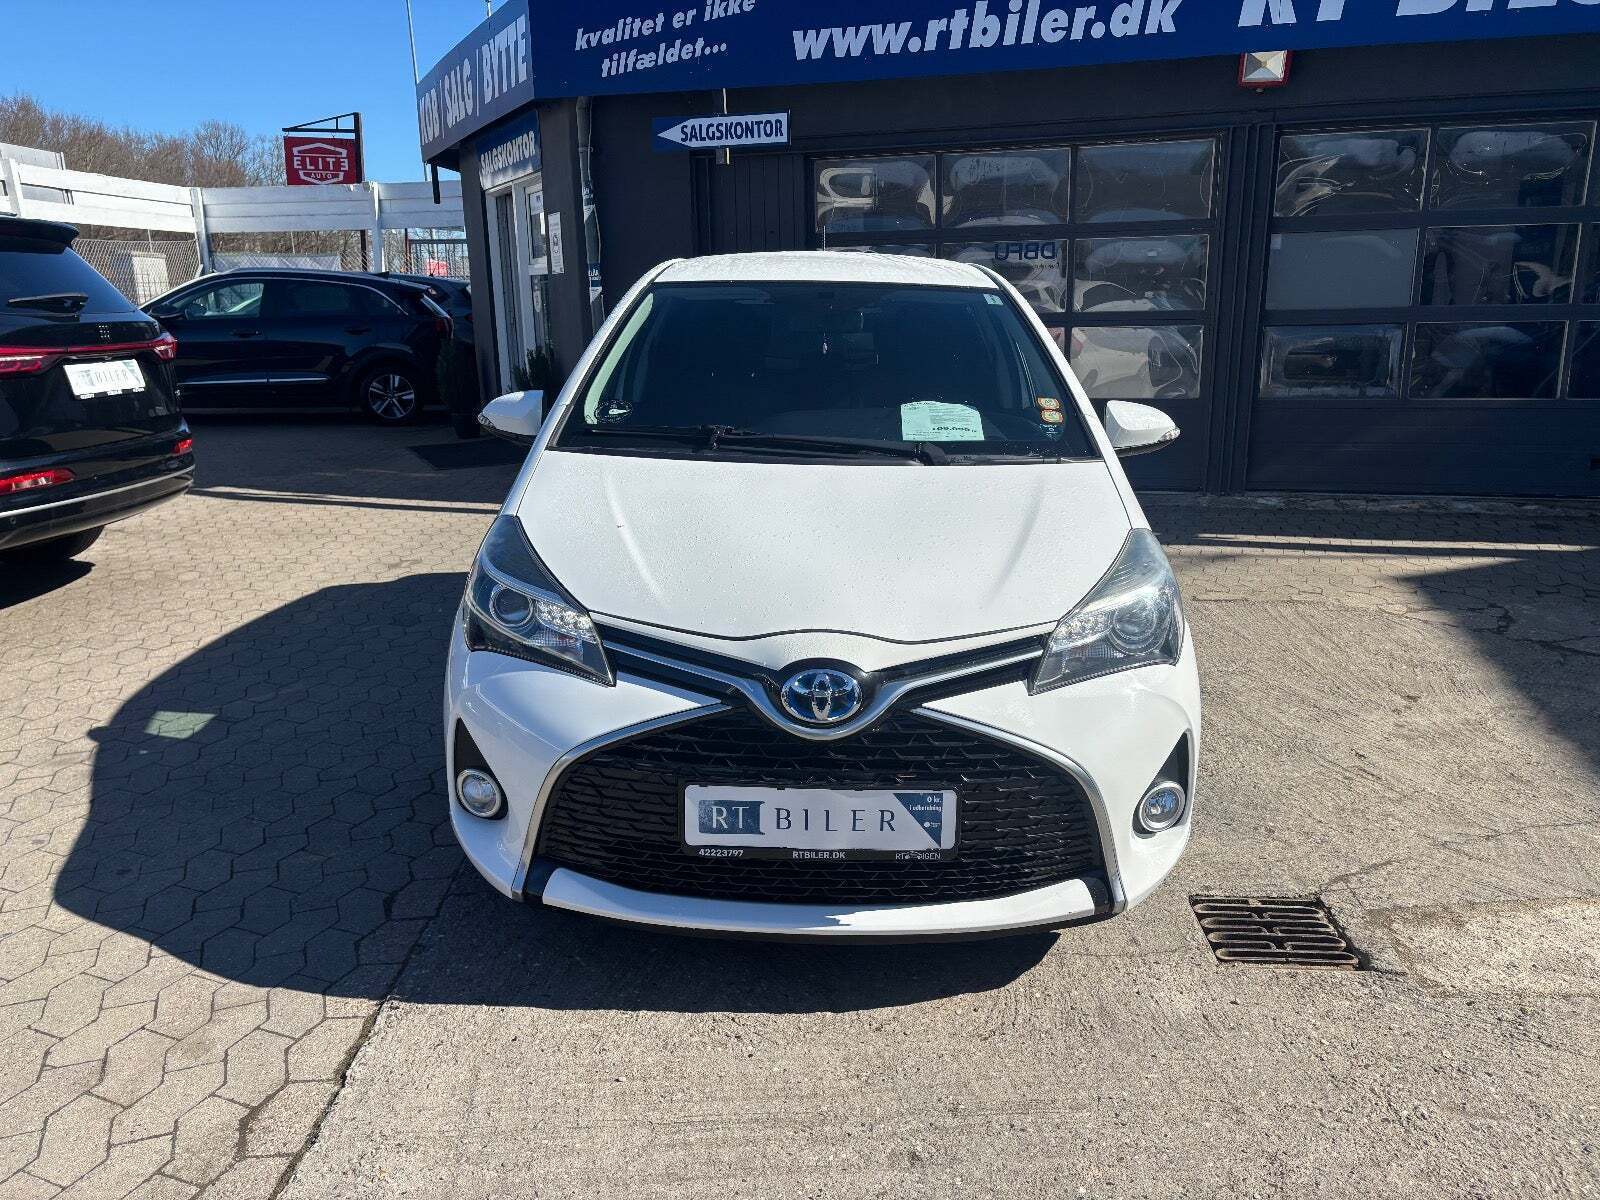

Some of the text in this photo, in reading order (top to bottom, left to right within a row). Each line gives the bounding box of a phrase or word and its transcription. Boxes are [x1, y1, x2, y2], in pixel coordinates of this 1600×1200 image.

[575, 0, 756, 51] kvalitet er ikke
[792, 0, 1182, 61] www.rtbiler.dk
[444, 58, 474, 129] SALG
[481, 13, 528, 105] BYTTE
[601, 37, 728, 78] tilfældet...
[680, 118, 784, 143] SALGSKONTOR
[293, 156, 349, 171] ELITE
[480, 130, 537, 175] SALGSKONTOR
[711, 805, 897, 832] RT BILER
[698, 848, 745, 858] 42223797
[792, 849, 846, 860] RTBILER.DK
